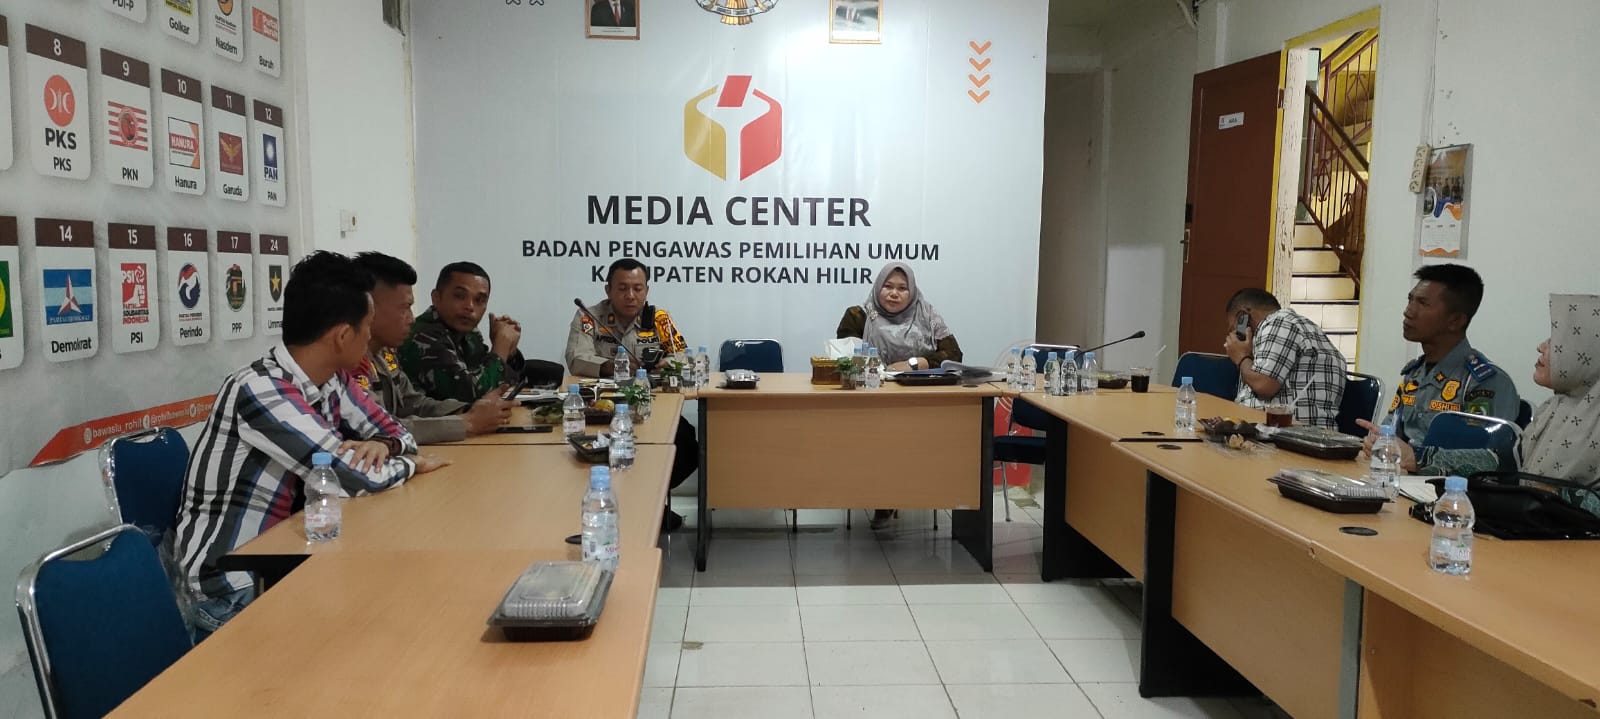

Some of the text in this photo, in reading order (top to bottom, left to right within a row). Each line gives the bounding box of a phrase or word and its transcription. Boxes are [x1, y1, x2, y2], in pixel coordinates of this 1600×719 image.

[168, 17, 190, 35] Golkar
[53, 38, 62, 56] 8
[215, 37, 238, 55] Nasdem
[258, 55, 274, 69] Buruh
[122, 63, 130, 77] 9
[177, 79, 187, 95] 10
[225, 94, 233, 109] 11
[264, 107, 273, 121] 12
[44, 127, 77, 150] PKS
[171, 135, 195, 151] HANURA
[53, 156, 72, 172] PKS
[121, 167, 139, 182] PKN
[263, 166, 279, 181] PAN
[174, 175, 198, 191] Hanura
[222, 183, 243, 197] Garuda
[267, 191, 278, 201] PAN
[587, 195, 872, 227] MEDIA CENTER
[59, 225, 73, 242] 14
[128, 229, 138, 245] 15
[183, 233, 193, 248] 16
[230, 236, 239, 249] 17
[270, 239, 279, 252] 24
[522, 240, 940, 261] BADAN PENGAWAS PEMILIHAN UMUM
[120, 270, 135, 284] PSI
[591, 265, 873, 285] KPATEN ROKAN HILIR
[231, 322, 242, 333] PPP
[267, 319, 284, 329] Umma
[130, 331, 144, 344] PSI
[179, 326, 203, 339] Perindo
[51, 336, 92, 354] Demokrat
